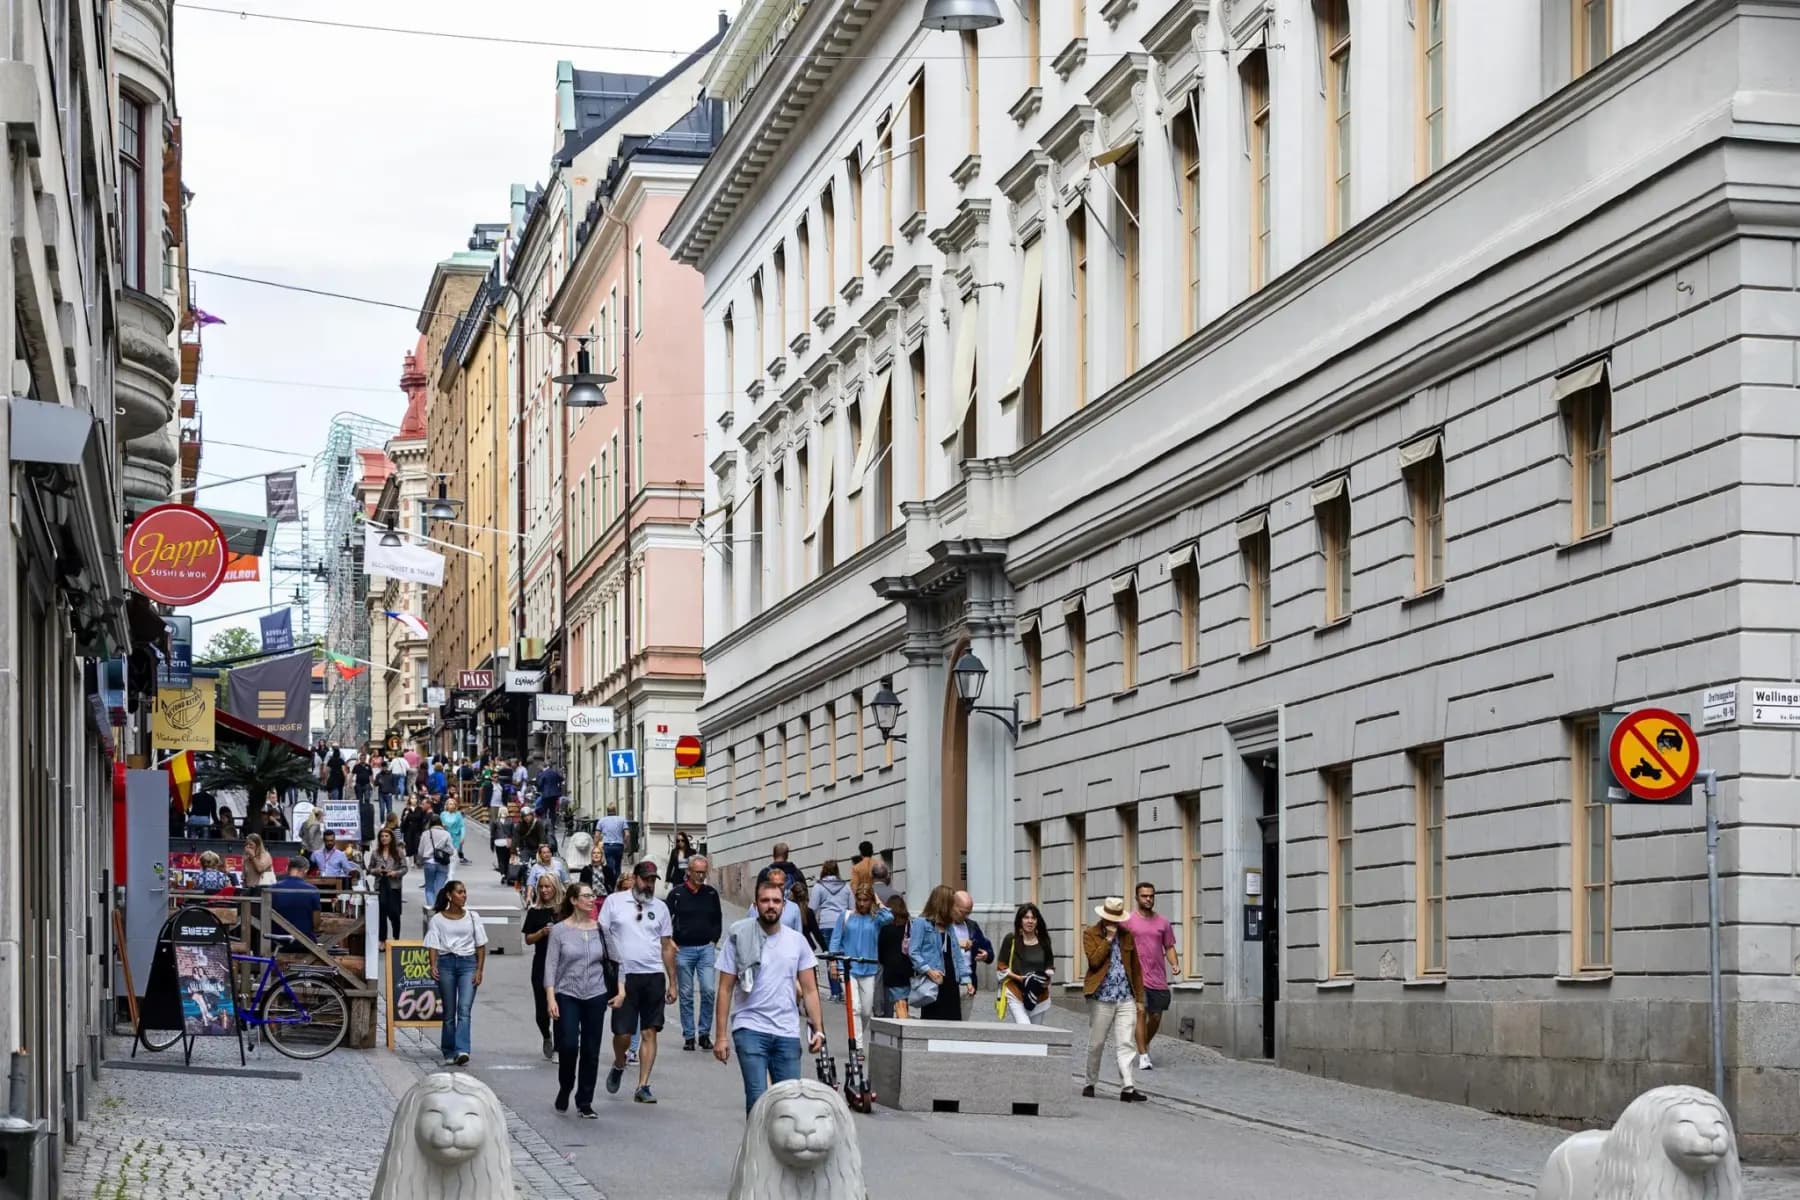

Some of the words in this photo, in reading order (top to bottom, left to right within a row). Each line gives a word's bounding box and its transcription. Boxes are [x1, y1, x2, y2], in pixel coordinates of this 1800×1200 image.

[132, 530, 219, 575] Jappi
[151, 568, 177, 577] SUSHI
[187, 570, 207, 578] WOK
[463, 671, 490, 687] PÄLS
[1755, 691, 1800, 705] Wallinga
[1756, 708, 1763, 719] 2
[267, 723, 303, 733] BURGER
[400, 949, 429, 967] LUNC
[404, 964, 431, 979] BOX
